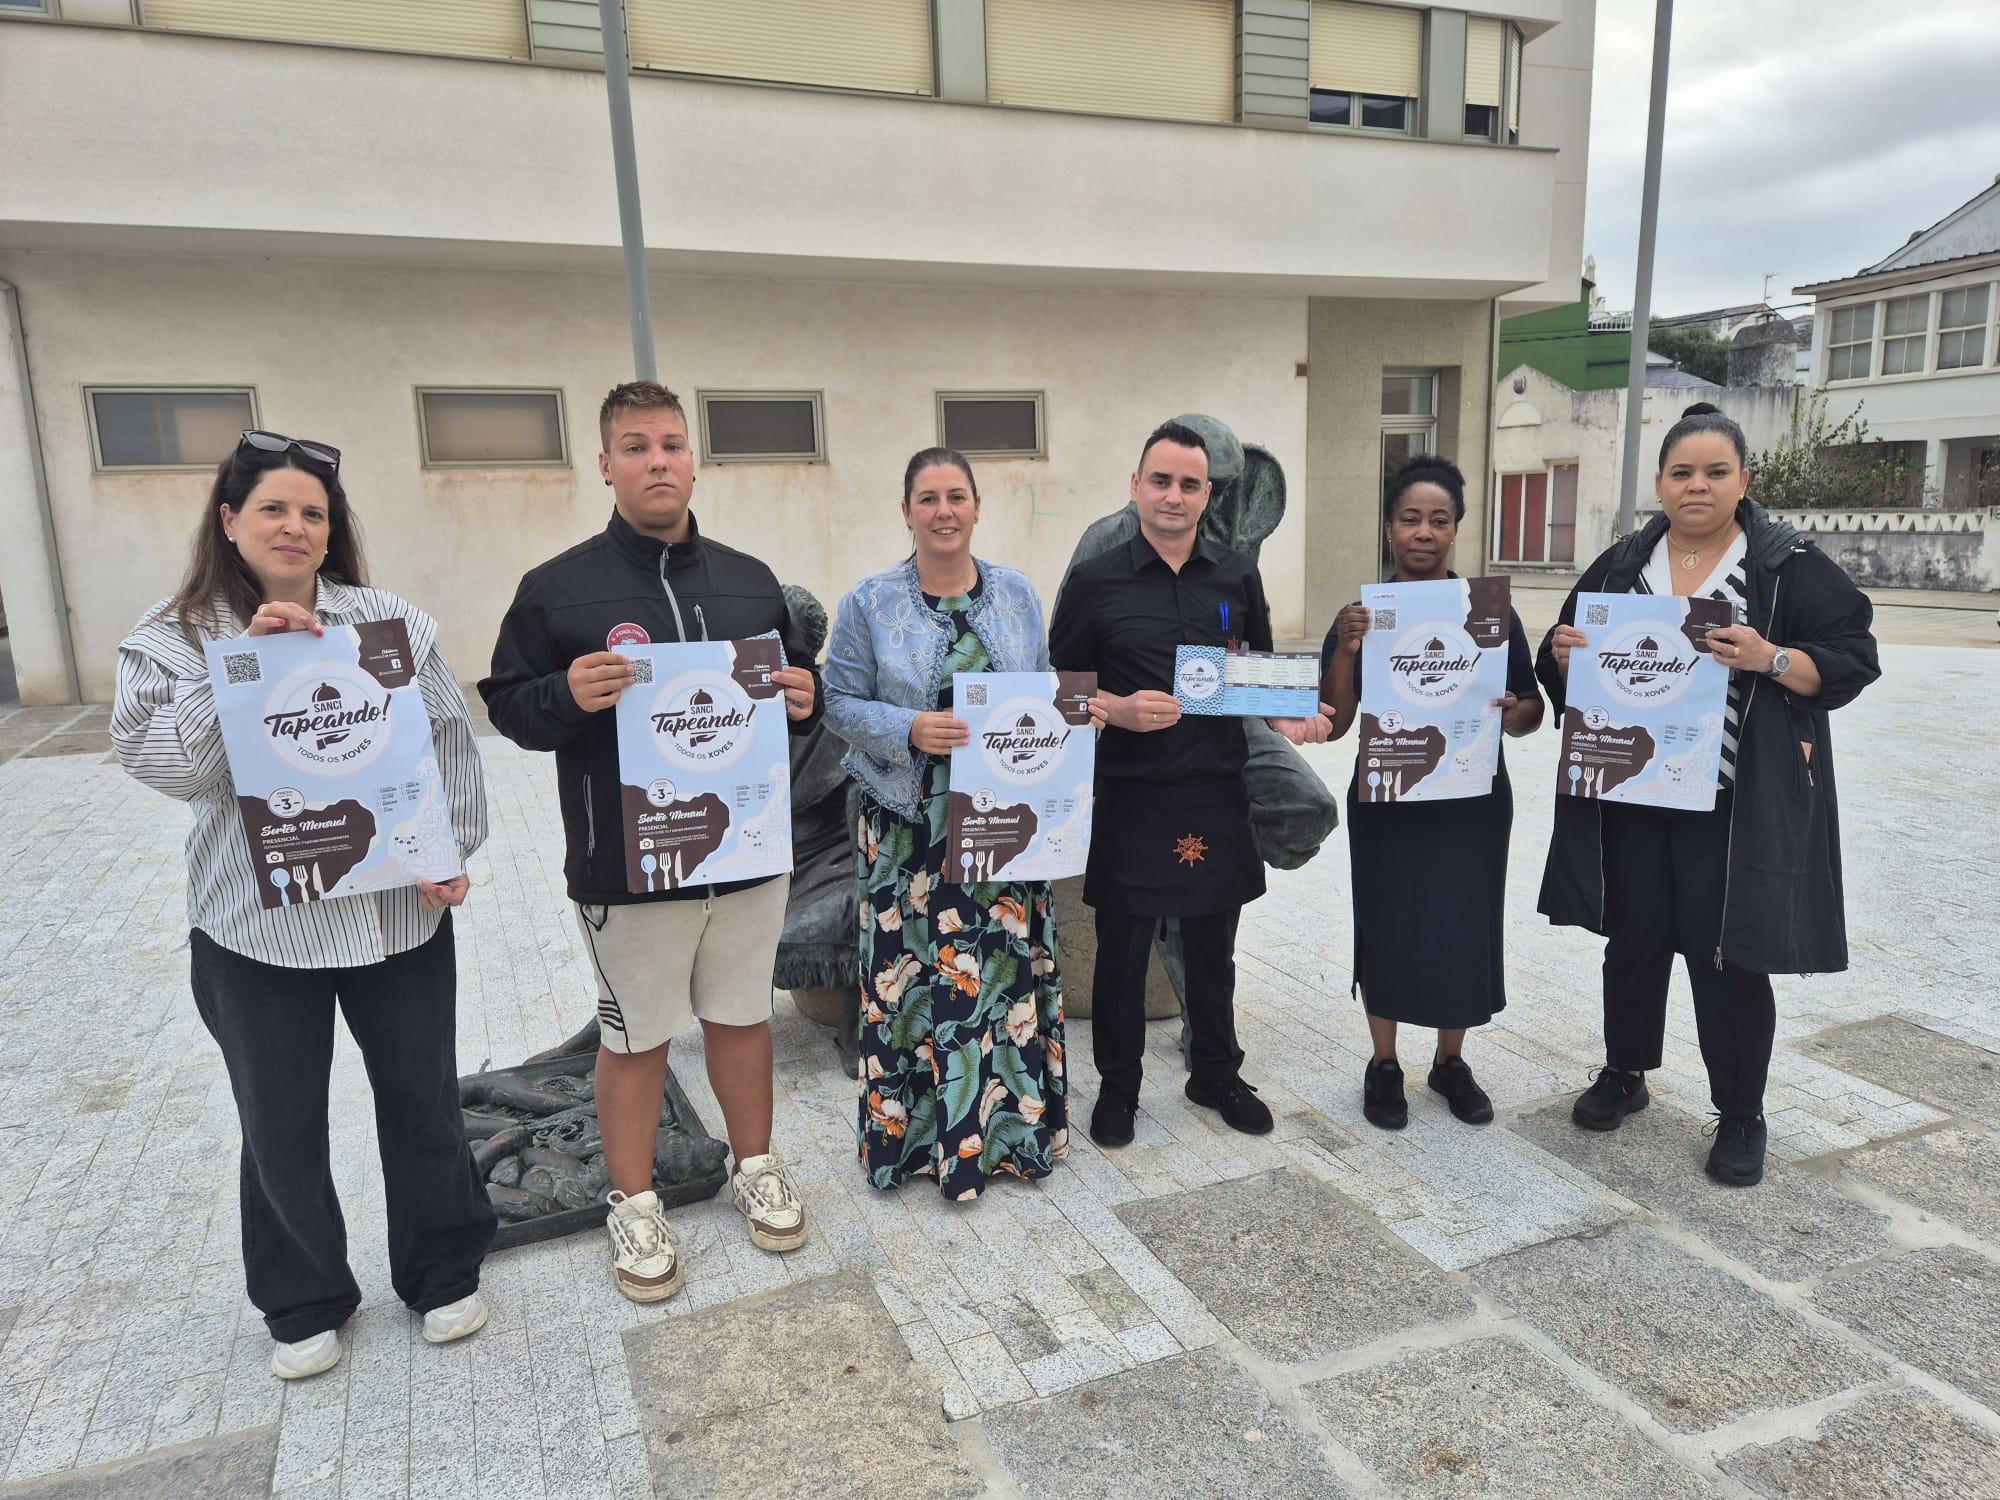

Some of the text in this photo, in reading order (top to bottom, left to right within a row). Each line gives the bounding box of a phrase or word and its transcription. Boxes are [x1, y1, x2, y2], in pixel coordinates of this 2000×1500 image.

[1389, 651, 1482, 676] Tapeando!
[1599, 652, 1700, 675] Tapeando!
[1635, 650, 1657, 659] SANCI
[1406, 681, 1423, 695] TODOS
[1435, 682, 1458, 697] XOVES
[1615, 679, 1632, 695] TODOS
[1644, 684, 1671, 698] XOVES
[314, 700, 342, 713] SANCI
[690, 705, 713, 715] SANCI
[263, 693, 391, 740] Tapeando!
[651, 703, 756, 737] Tapeando!
[298, 747, 324, 762] TODOS
[341, 738, 372, 761] XOVES
[674, 743, 694, 759] TODOS
[708, 740, 734, 759] XOVES
[982, 728, 1071, 754] Tapeando!
[1000, 758, 1015, 773] TODOS
[1026, 759, 1049, 775] XOVES
[638, 806, 707, 824] Sorteo Mensual
[261, 815, 347, 837] Sorteo Mensual
[262, 836, 300, 845] PRESENCIAL
